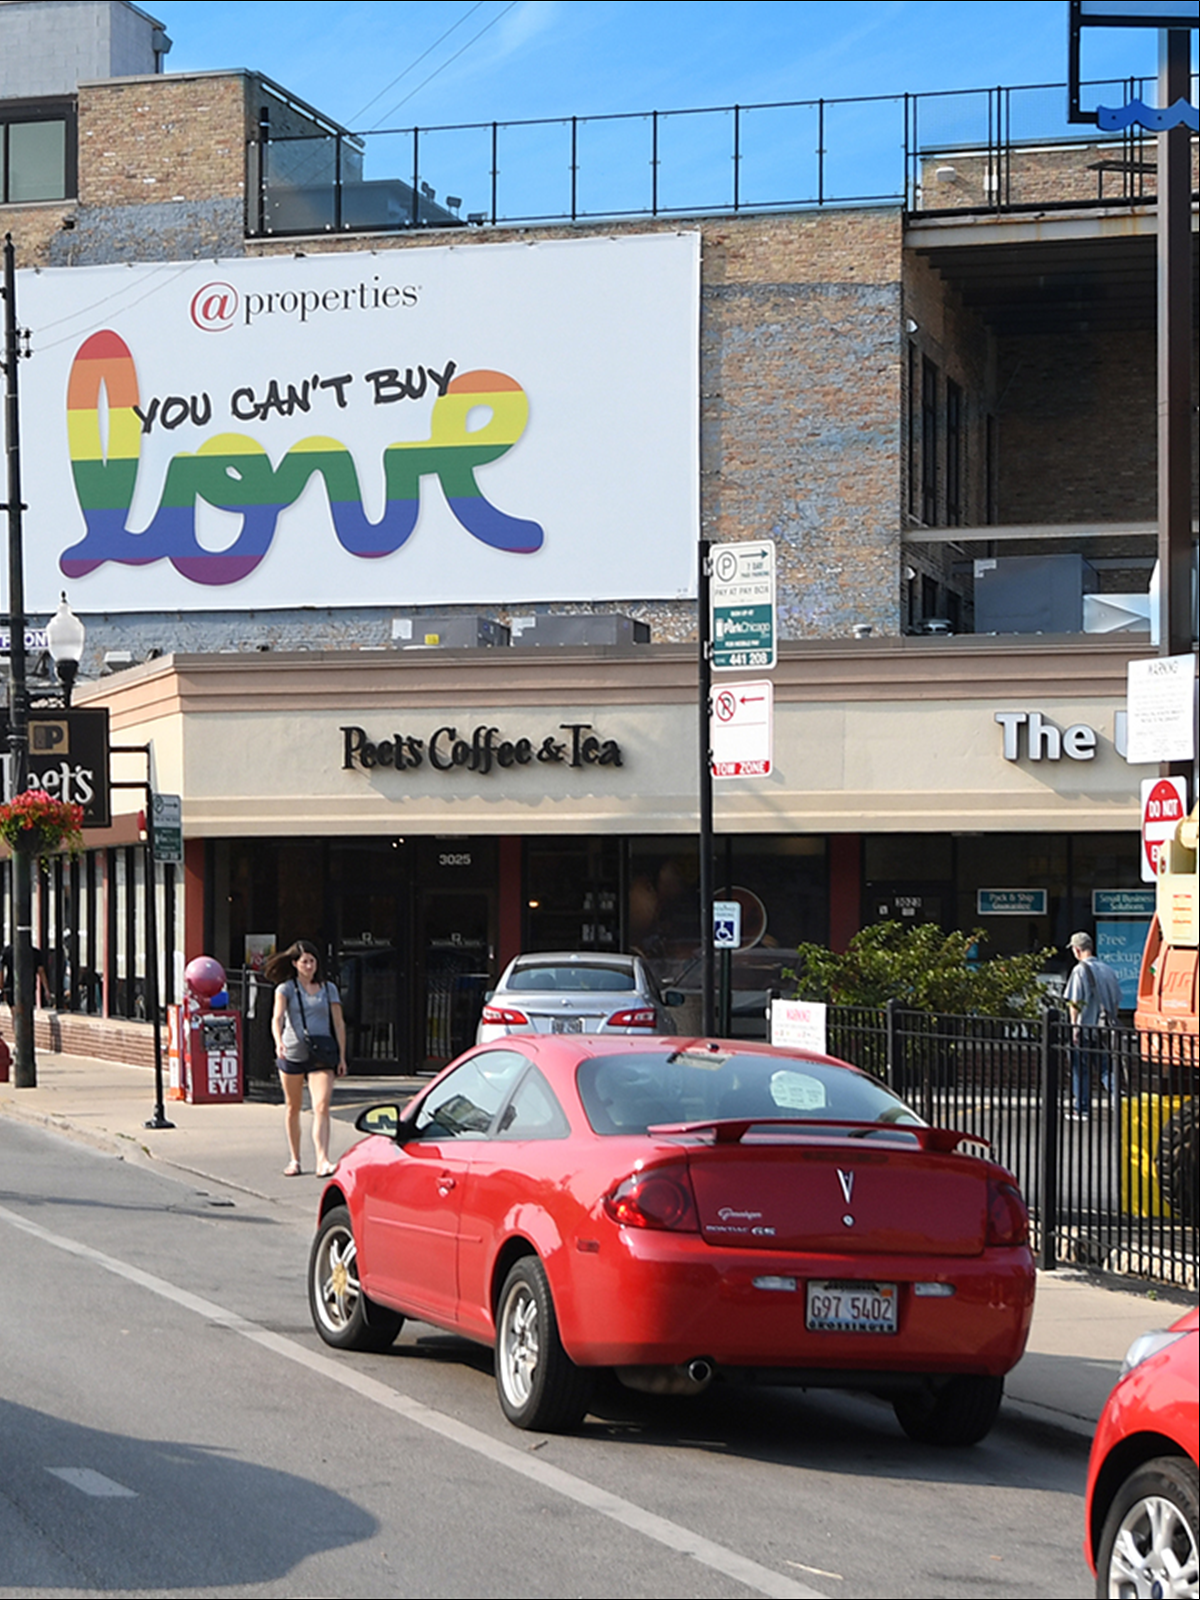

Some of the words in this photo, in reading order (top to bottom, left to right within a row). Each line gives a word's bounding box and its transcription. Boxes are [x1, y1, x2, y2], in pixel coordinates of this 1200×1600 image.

[133, 394, 211, 434] YOU
[232, 374, 352, 421] CAN'T
[365, 360, 456, 405] BUY
[59, 329, 544, 586] love
[729, 653, 747, 665] 441
[994, 712, 1097, 761] The
[340, 726, 423, 770] Peet's
[429, 726, 532, 774] Coffee
[536, 737, 564, 762] &
[560, 724, 622, 767] Tea
[715, 762, 735, 775] TOW
[740, 761, 765, 775] ZONE
[1150, 802, 1160, 817] DO
[1162, 800, 1178, 816] NOT
[439, 853, 471, 866] 3025
[1110, 902, 1145, 911] Solutions
[1099, 933, 1127, 946] Free
[1100, 950, 1141, 966] pickup
[207, 1056, 238, 1079] ED
[208, 1079, 238, 1094] EYE
[811, 1295, 841, 1319] G97
[850, 1297, 892, 1321] 5402
